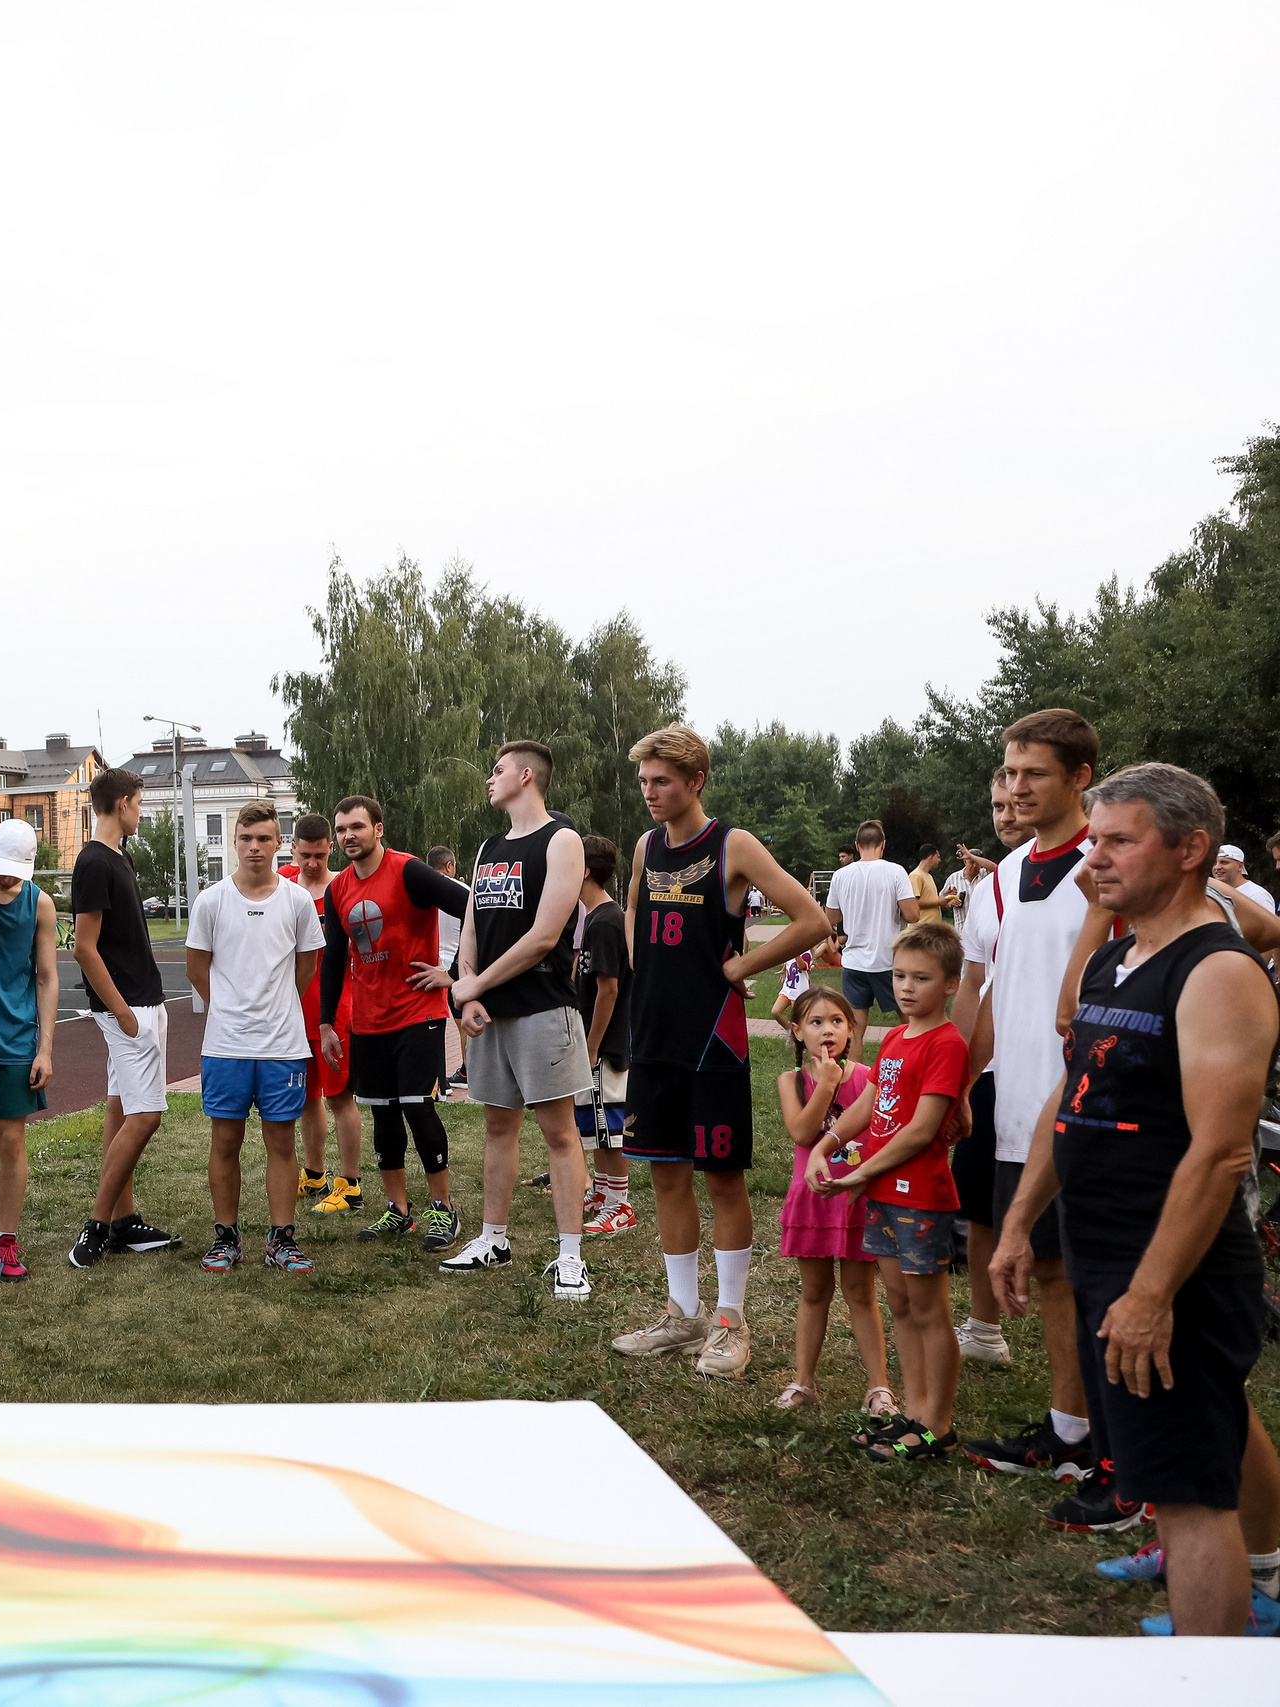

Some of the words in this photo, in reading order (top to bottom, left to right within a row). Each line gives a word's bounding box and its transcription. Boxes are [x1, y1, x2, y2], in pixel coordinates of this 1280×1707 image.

[475, 861, 522, 894] USA
[477, 895, 506, 905] BSETBLL
[651, 892, 702, 903] СТРЕМЛЕНИЕ
[650, 910, 683, 946] 18
[287, 1072, 307, 1088] JO
[597, 1108, 606, 1130] PUMA
[694, 1125, 732, 1158] 18
